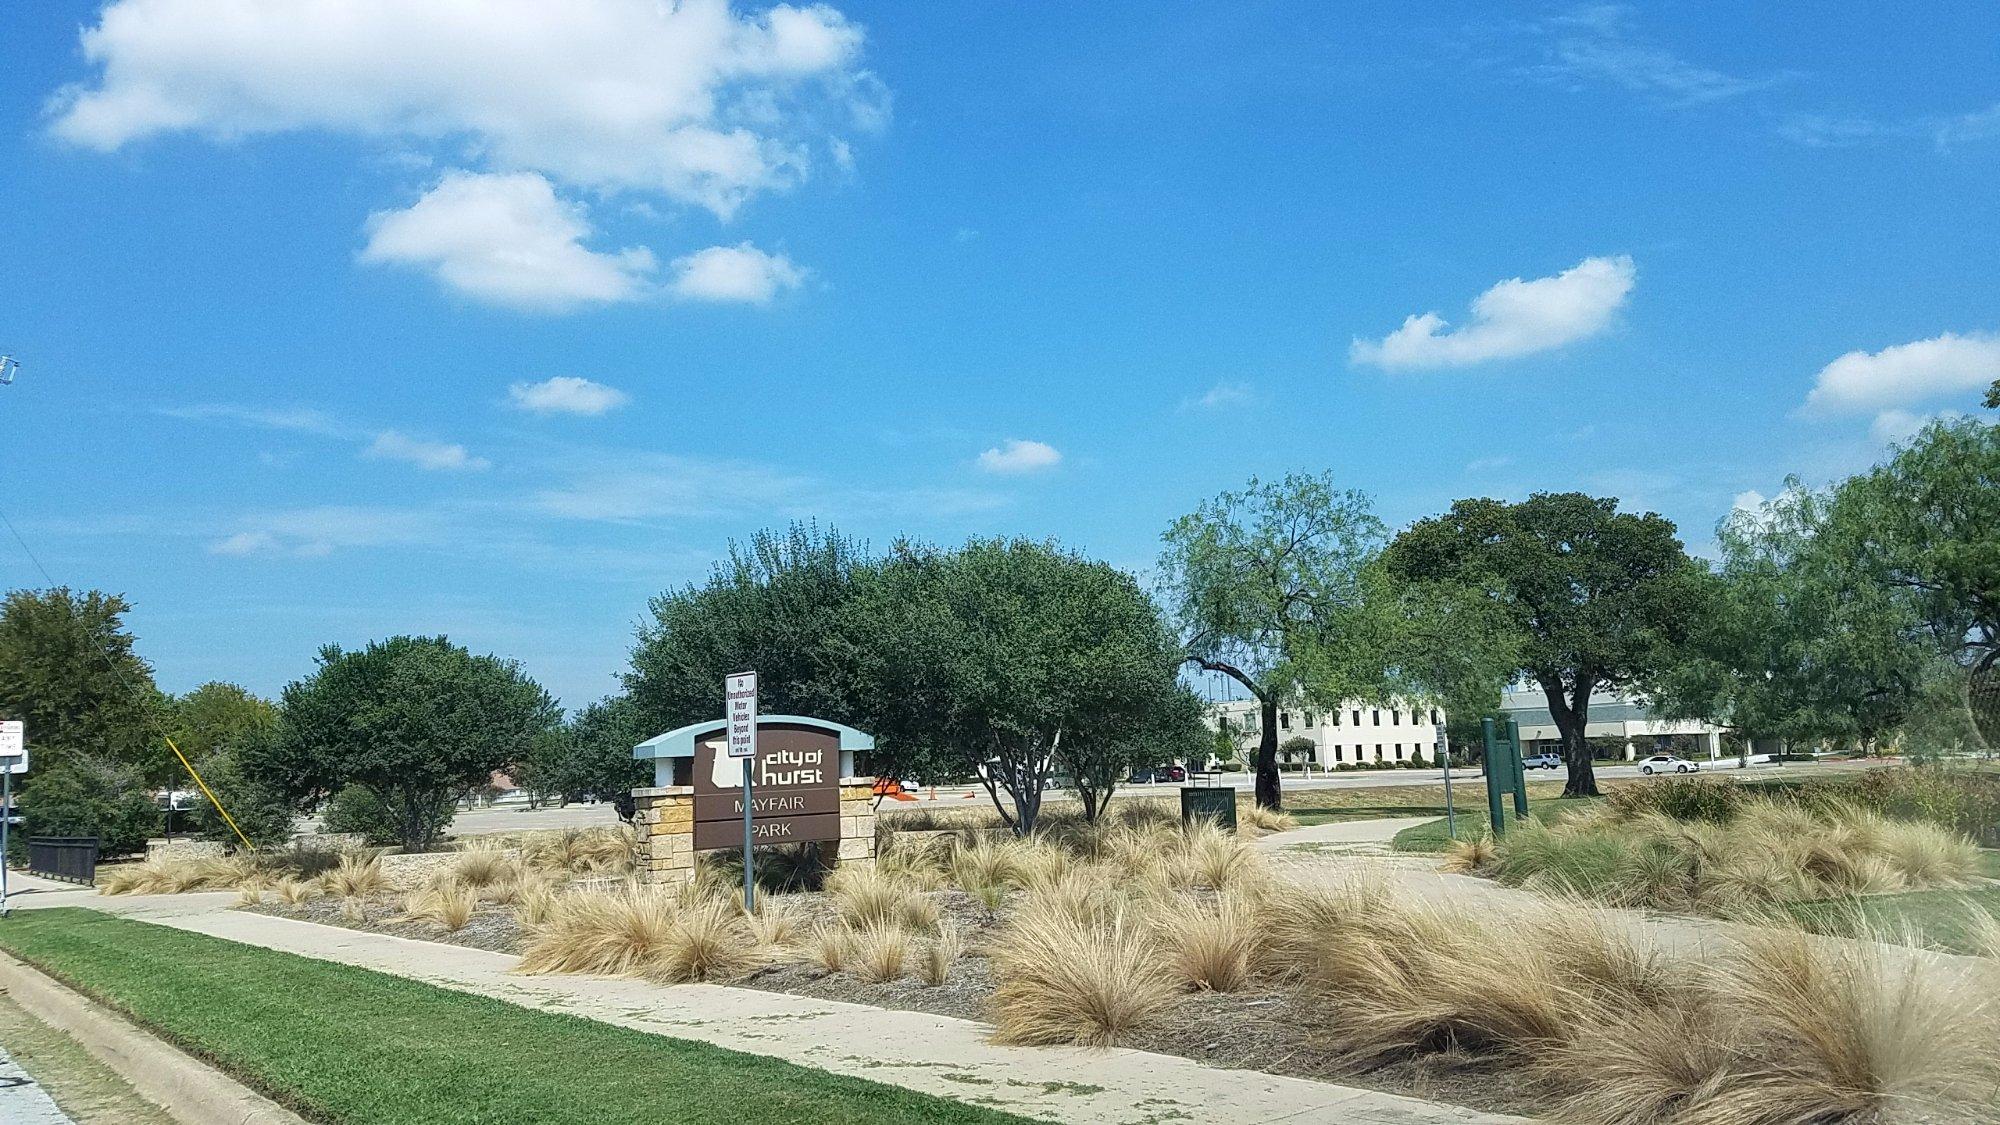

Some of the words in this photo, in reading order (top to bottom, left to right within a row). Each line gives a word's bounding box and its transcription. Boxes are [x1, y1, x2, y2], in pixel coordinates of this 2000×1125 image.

[733, 724, 749, 735] Beyond
[766, 750, 802, 767] city
[805, 749, 823, 765] of
[762, 759, 823, 786] hurst
[734, 796, 805, 813] MAYFAIR
